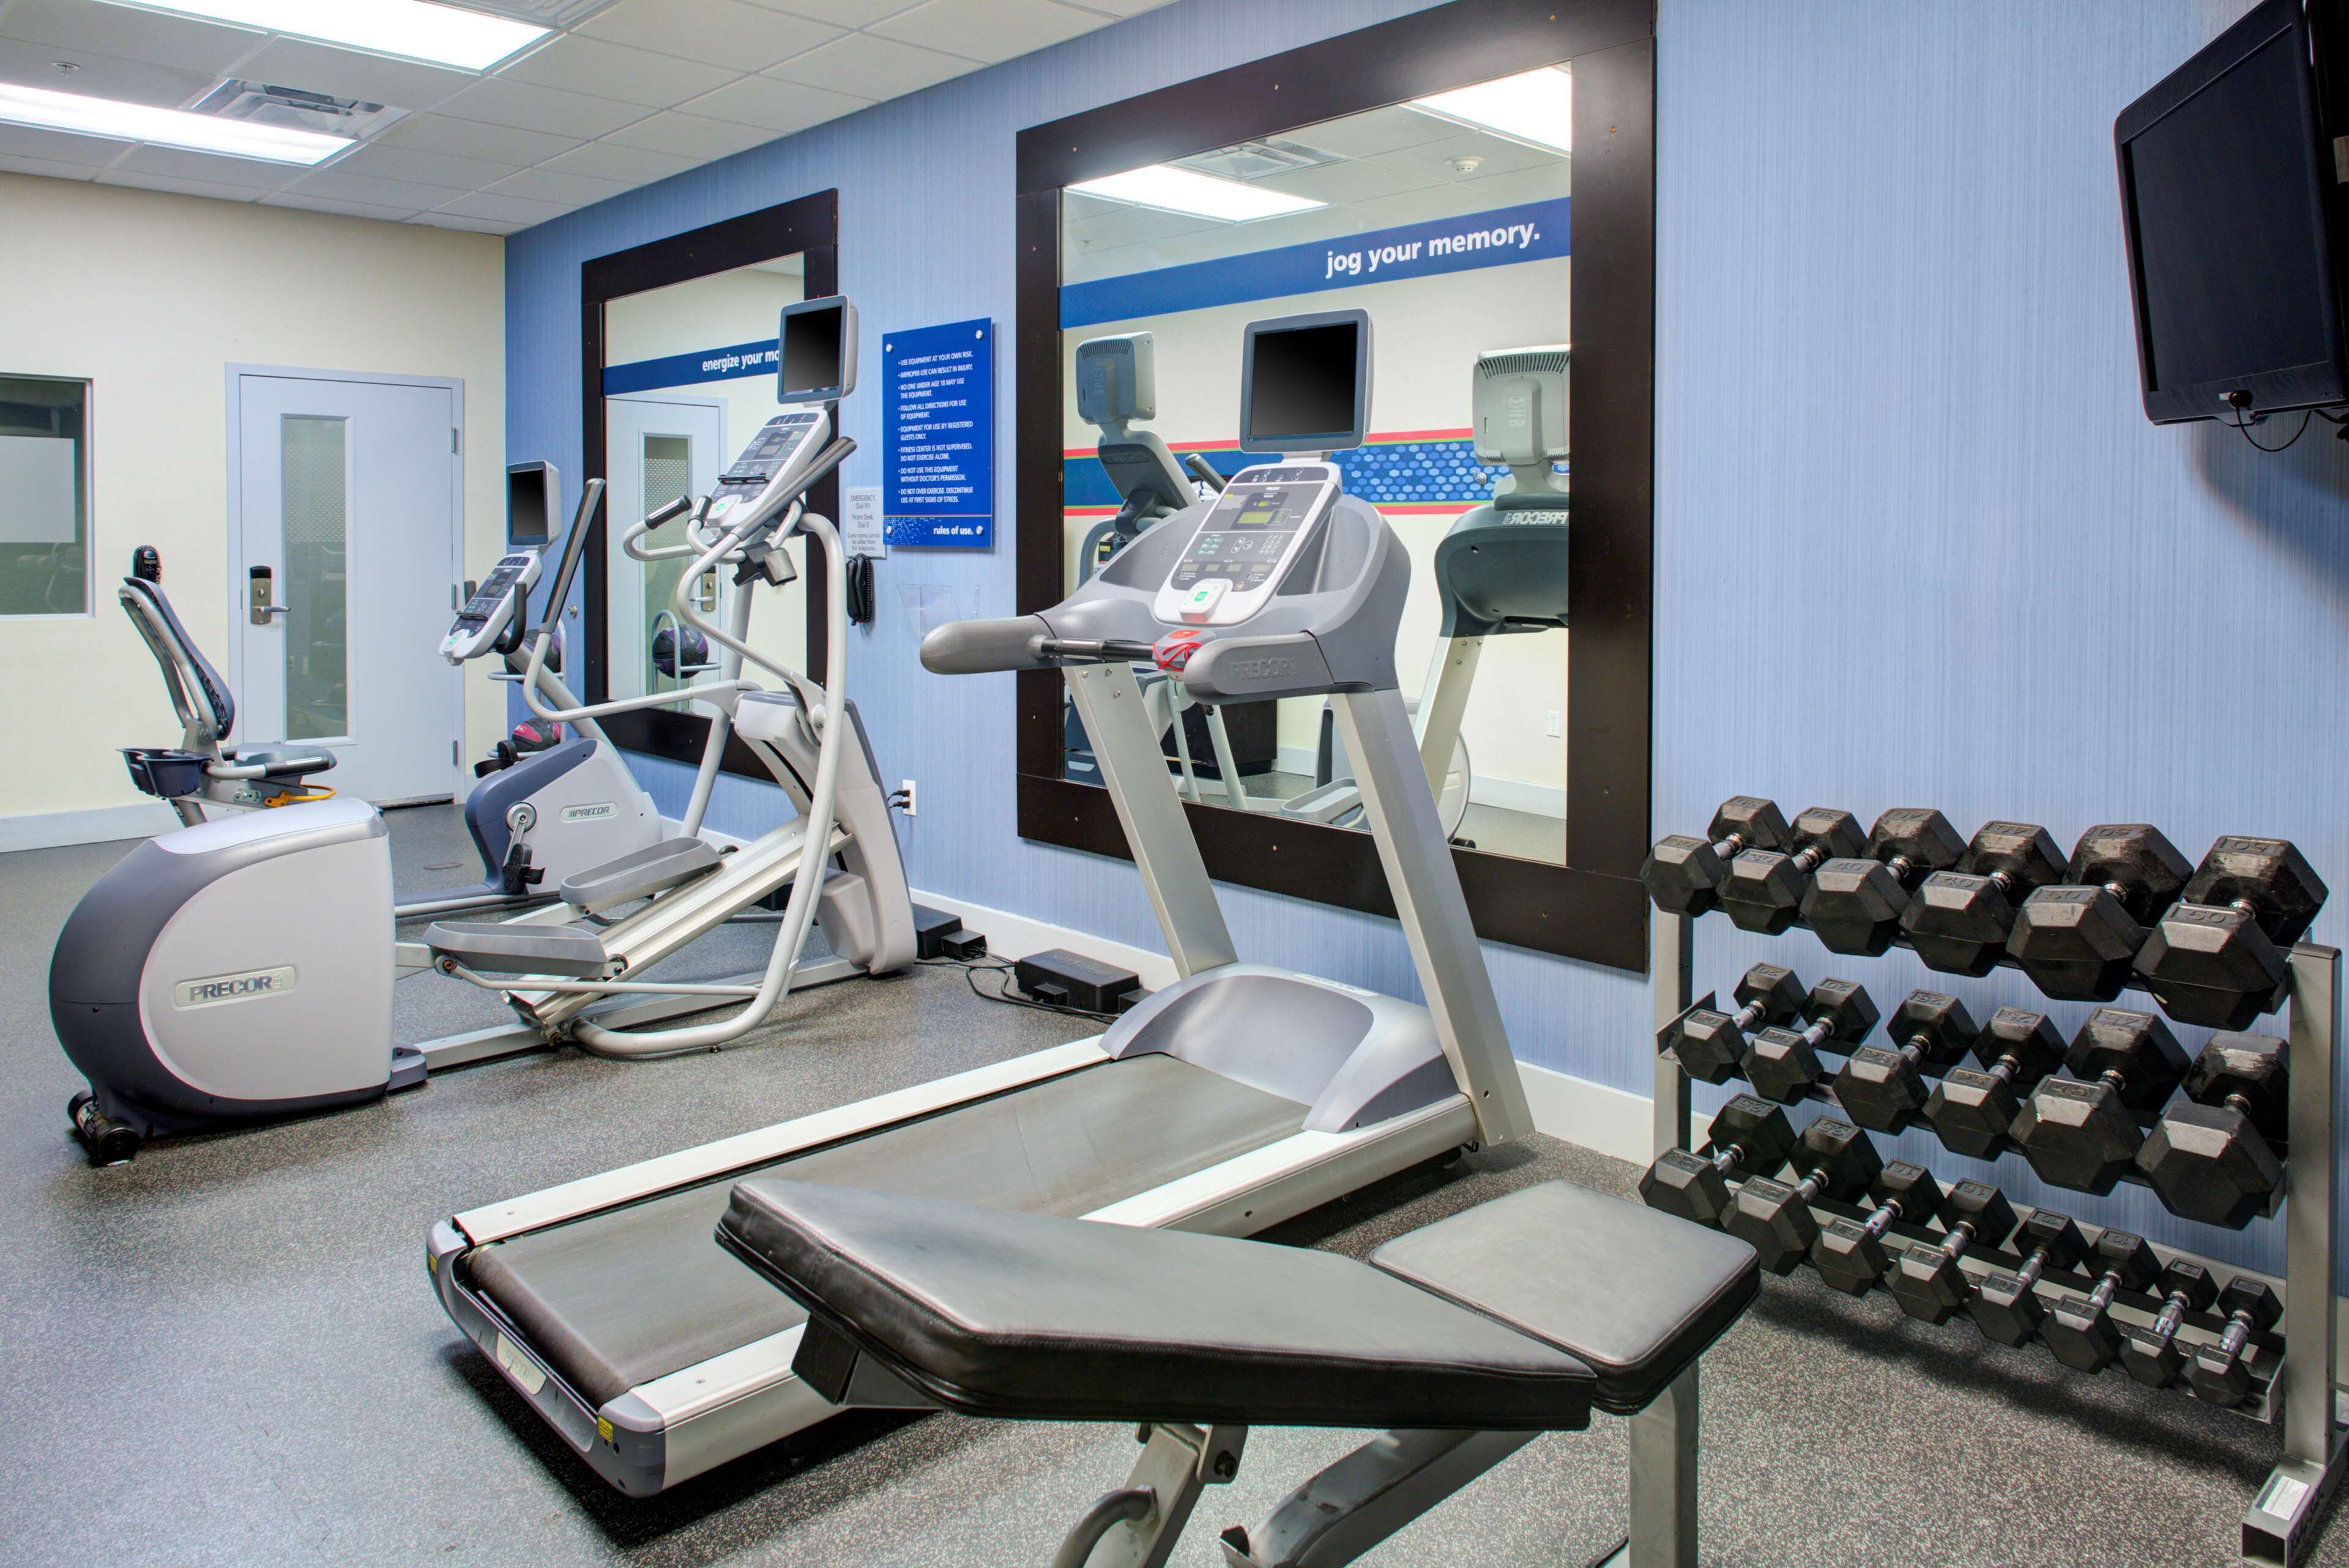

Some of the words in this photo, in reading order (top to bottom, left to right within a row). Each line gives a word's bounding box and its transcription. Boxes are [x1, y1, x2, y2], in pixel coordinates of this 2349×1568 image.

[1325, 251, 1362, 280] jog
[1368, 241, 1422, 273] your
[1428, 223, 1540, 257] memory.
[702, 354, 740, 373] energize
[741, 352, 764, 370] your
[908, 356, 931, 365] EQUIPMENT
[933, 525, 950, 535] rules
[951, 525, 959, 535] of
[1229, 658, 1292, 680] PRECOR
[575, 806, 610, 817] PRECOR
[2098, 827, 2130, 837] 50
[2232, 840, 2269, 852] 50
[1940, 876, 1976, 888] 40
[2044, 890, 2080, 901] 50
[2184, 909, 2228, 924] 50
[1759, 966, 1782, 977] 20
[273, 972, 285, 989] USA
[1826, 981, 1851, 992] 20
[189, 975, 273, 1001] PRECOR
[1696, 1014, 1721, 1025] 20
[1957, 1072, 1986, 1085] 25
[2050, 1083, 2090, 1098] 45
[1820, 1122, 1850, 1136] 35
